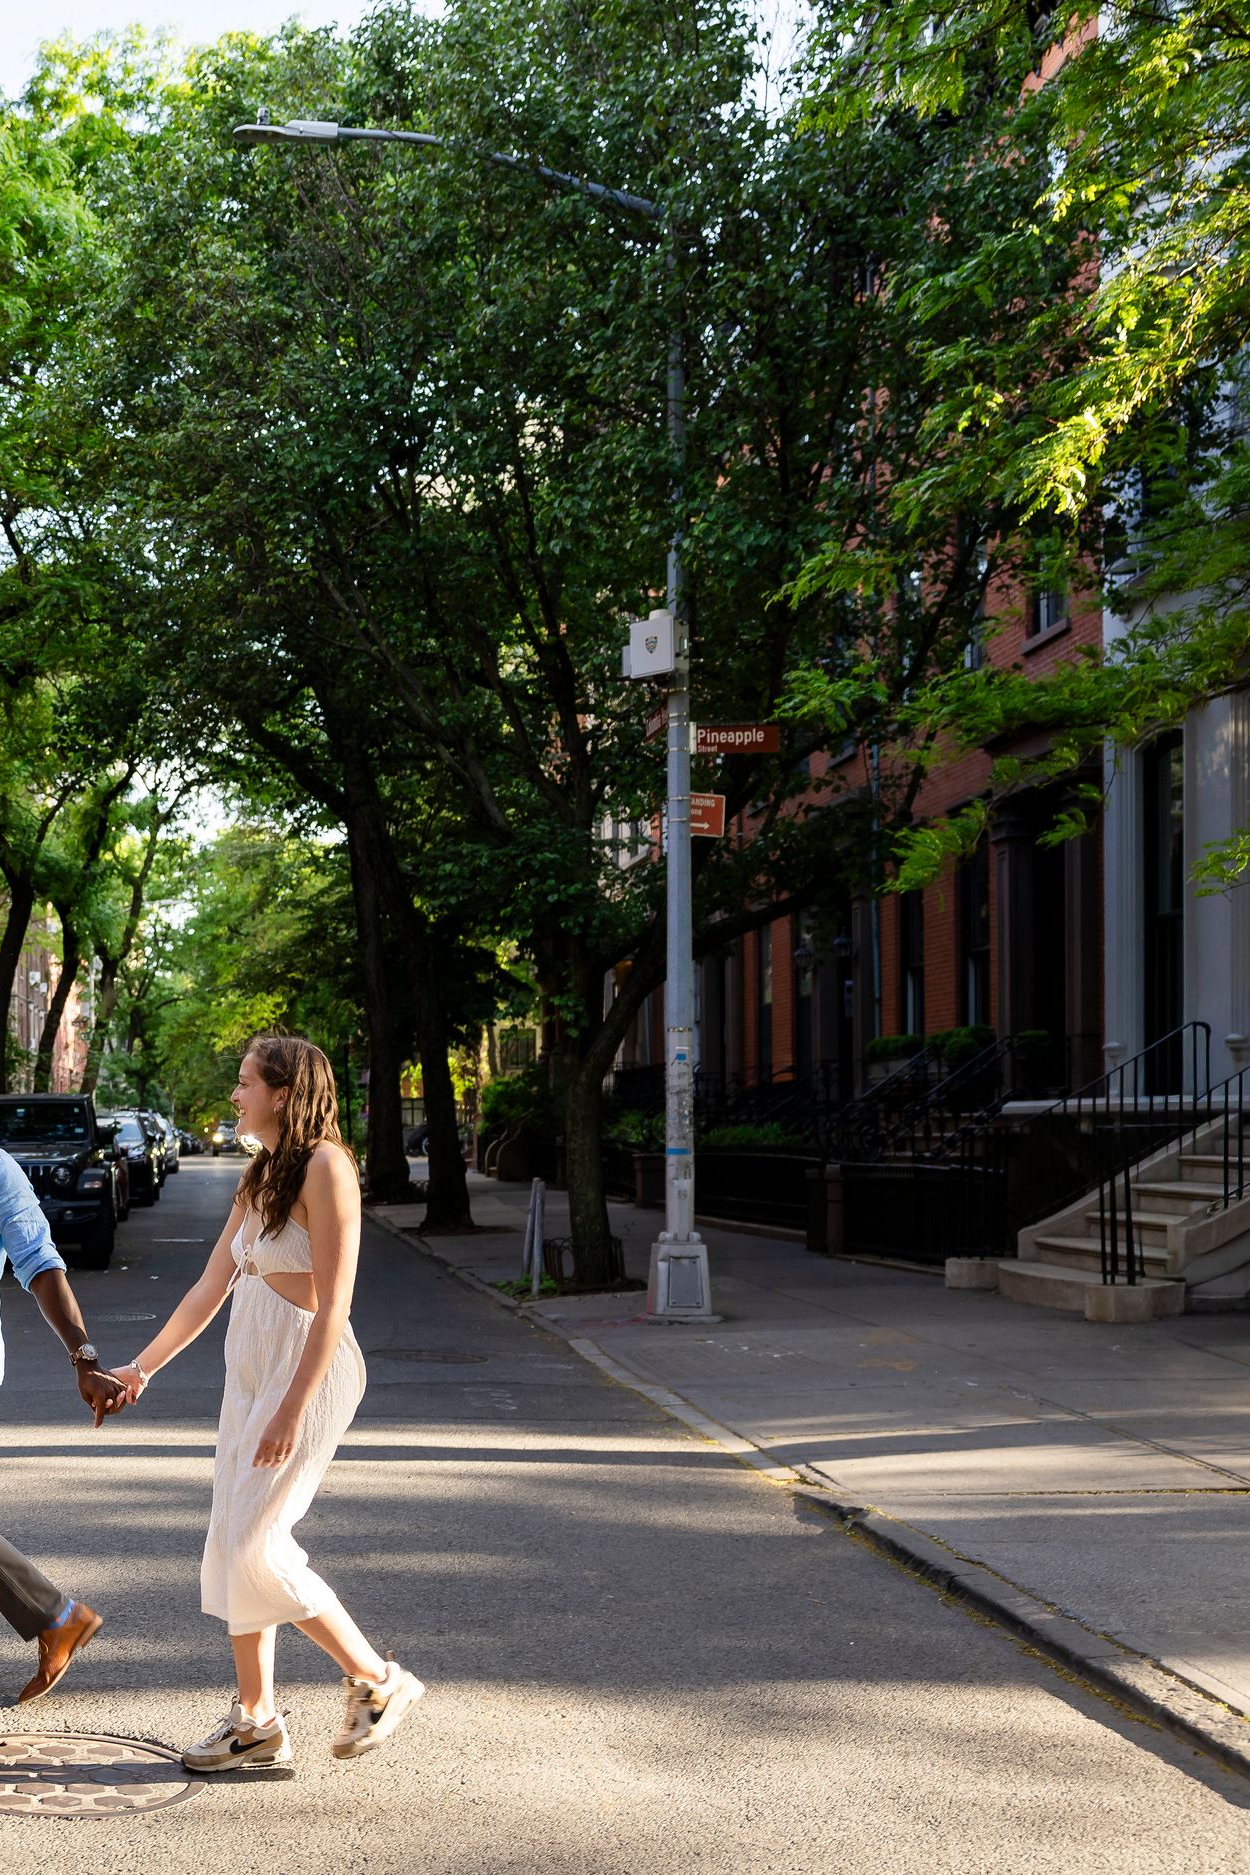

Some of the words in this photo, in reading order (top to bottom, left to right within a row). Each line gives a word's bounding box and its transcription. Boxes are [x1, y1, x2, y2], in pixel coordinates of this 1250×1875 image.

[697, 728, 764, 745] Pineapple
[697, 744, 718, 752] Street
[690, 798, 715, 807] ANDING
[690, 808, 702, 816] one
